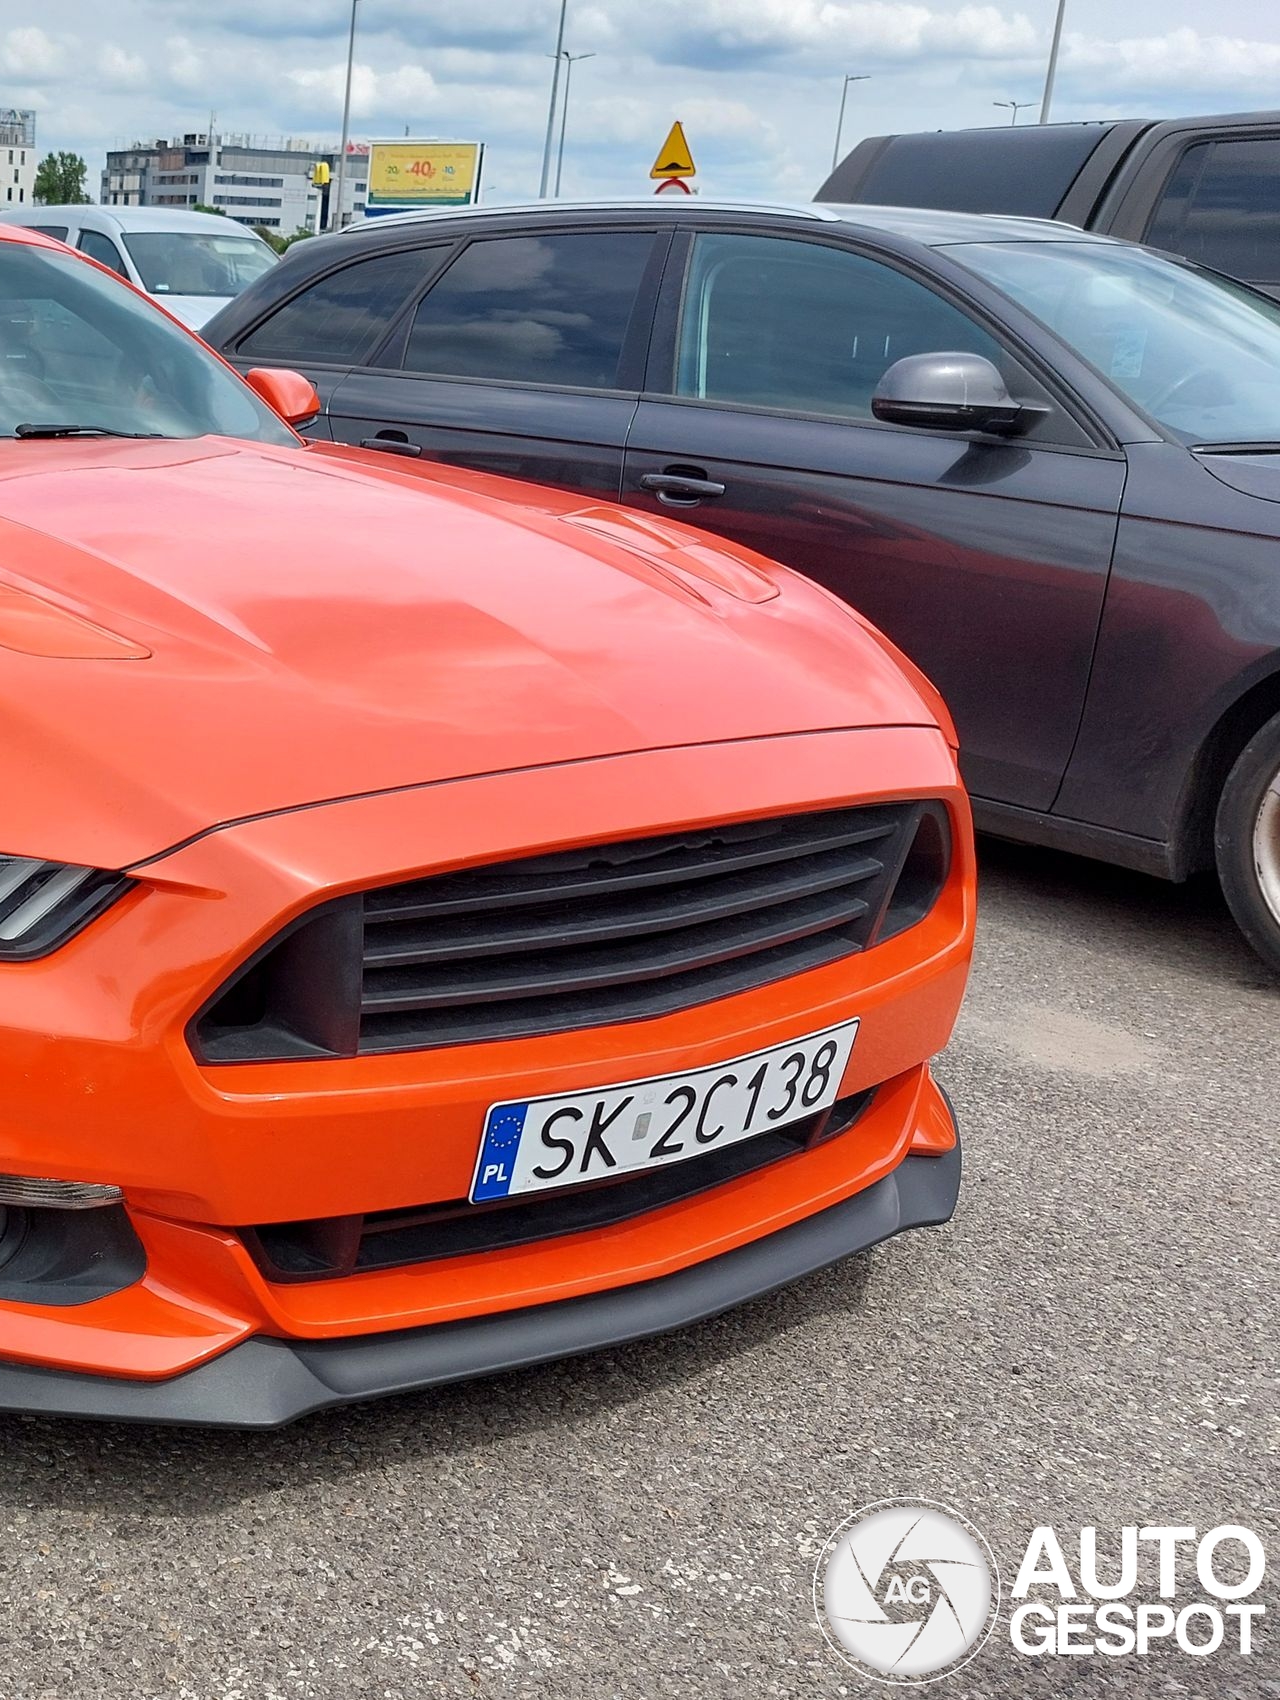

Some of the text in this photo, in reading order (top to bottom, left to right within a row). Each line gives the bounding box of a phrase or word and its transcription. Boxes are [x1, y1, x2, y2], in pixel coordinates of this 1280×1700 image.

[532, 1039, 838, 1180] SK 2C138
[482, 1162, 508, 1185] PL
